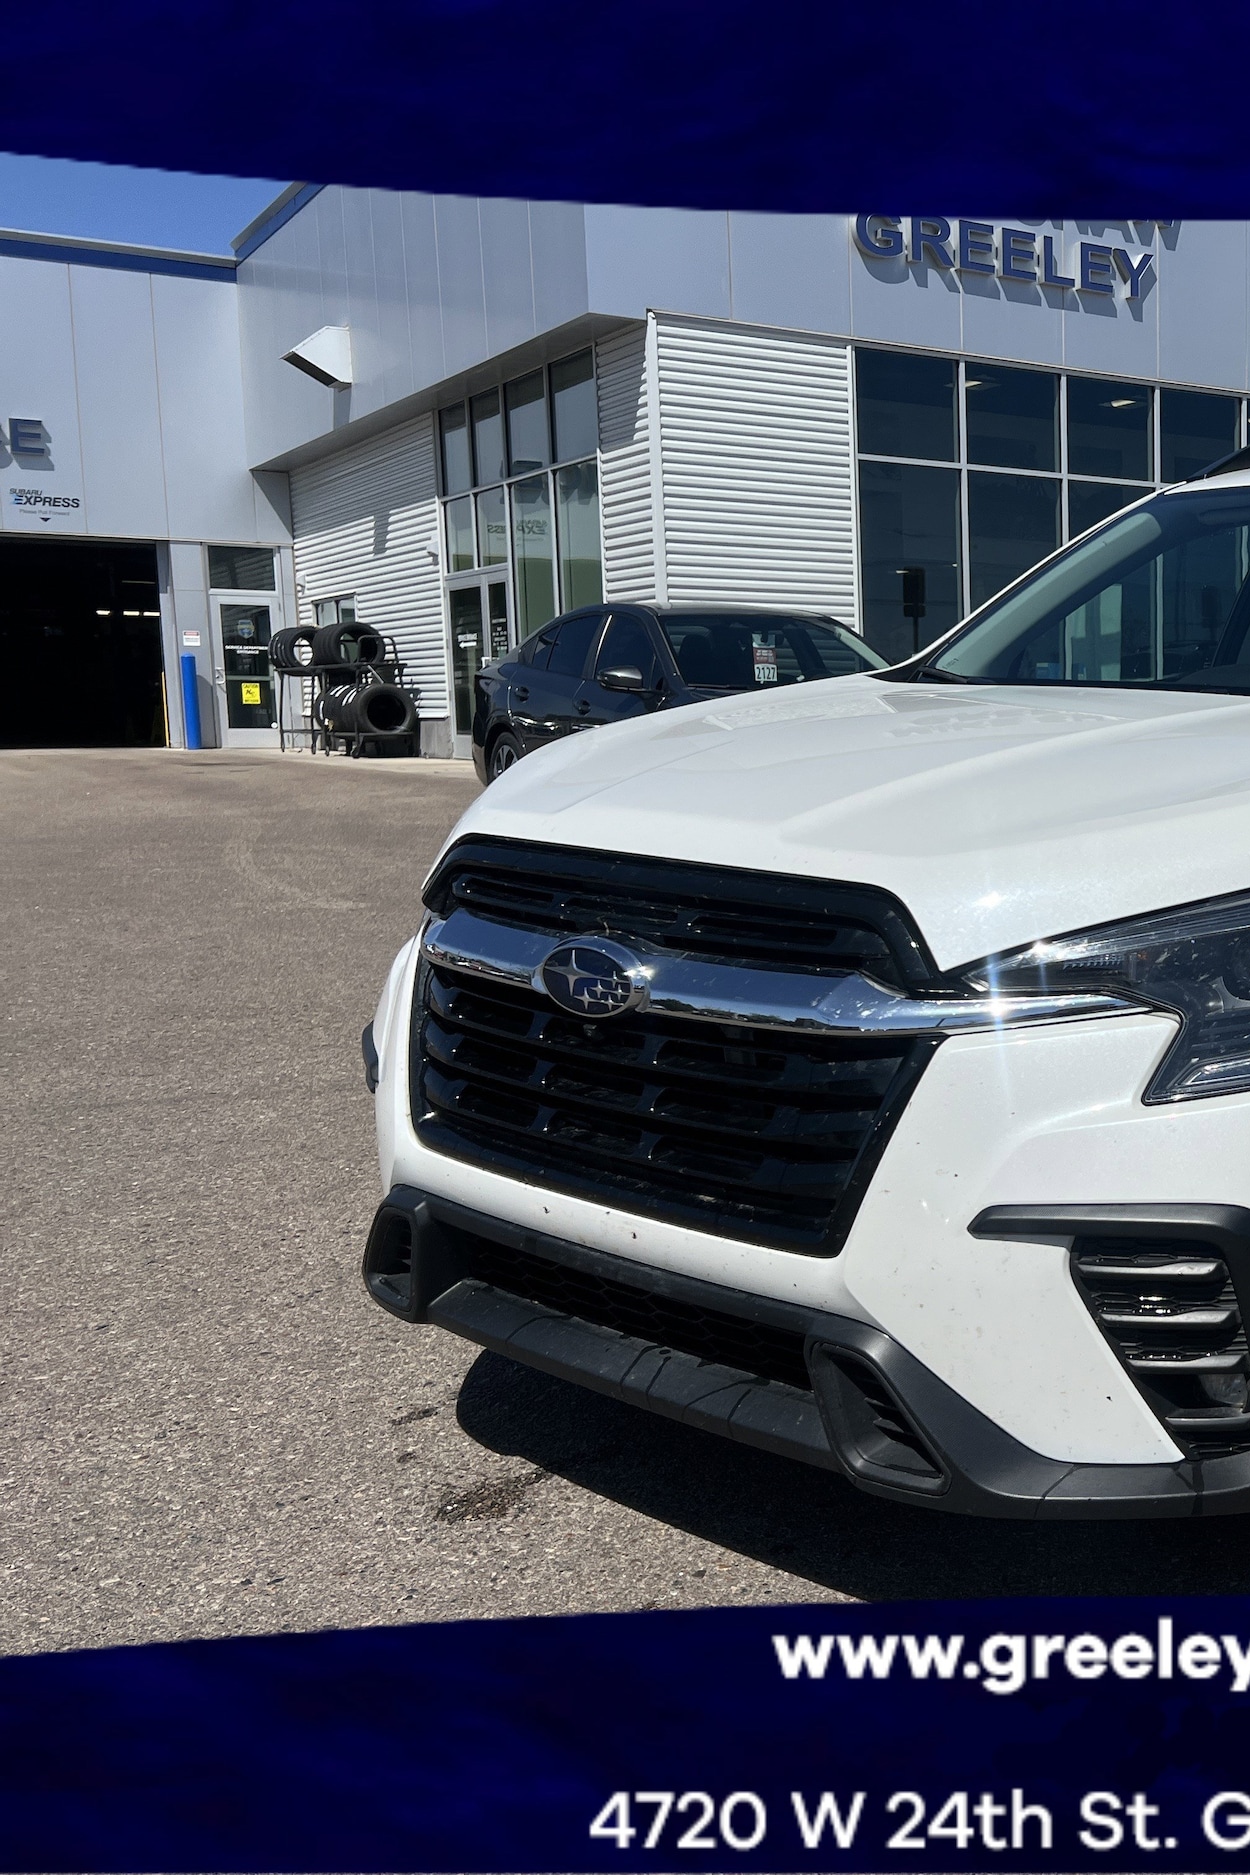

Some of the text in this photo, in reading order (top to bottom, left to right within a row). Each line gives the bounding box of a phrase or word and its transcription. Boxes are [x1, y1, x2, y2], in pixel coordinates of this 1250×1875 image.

[853, 213, 1154, 299] GREELEY
[9, 488, 42, 496] SUBARU
[13, 494, 80, 508] EXPRESS
[756, 666, 775, 680] 2127
